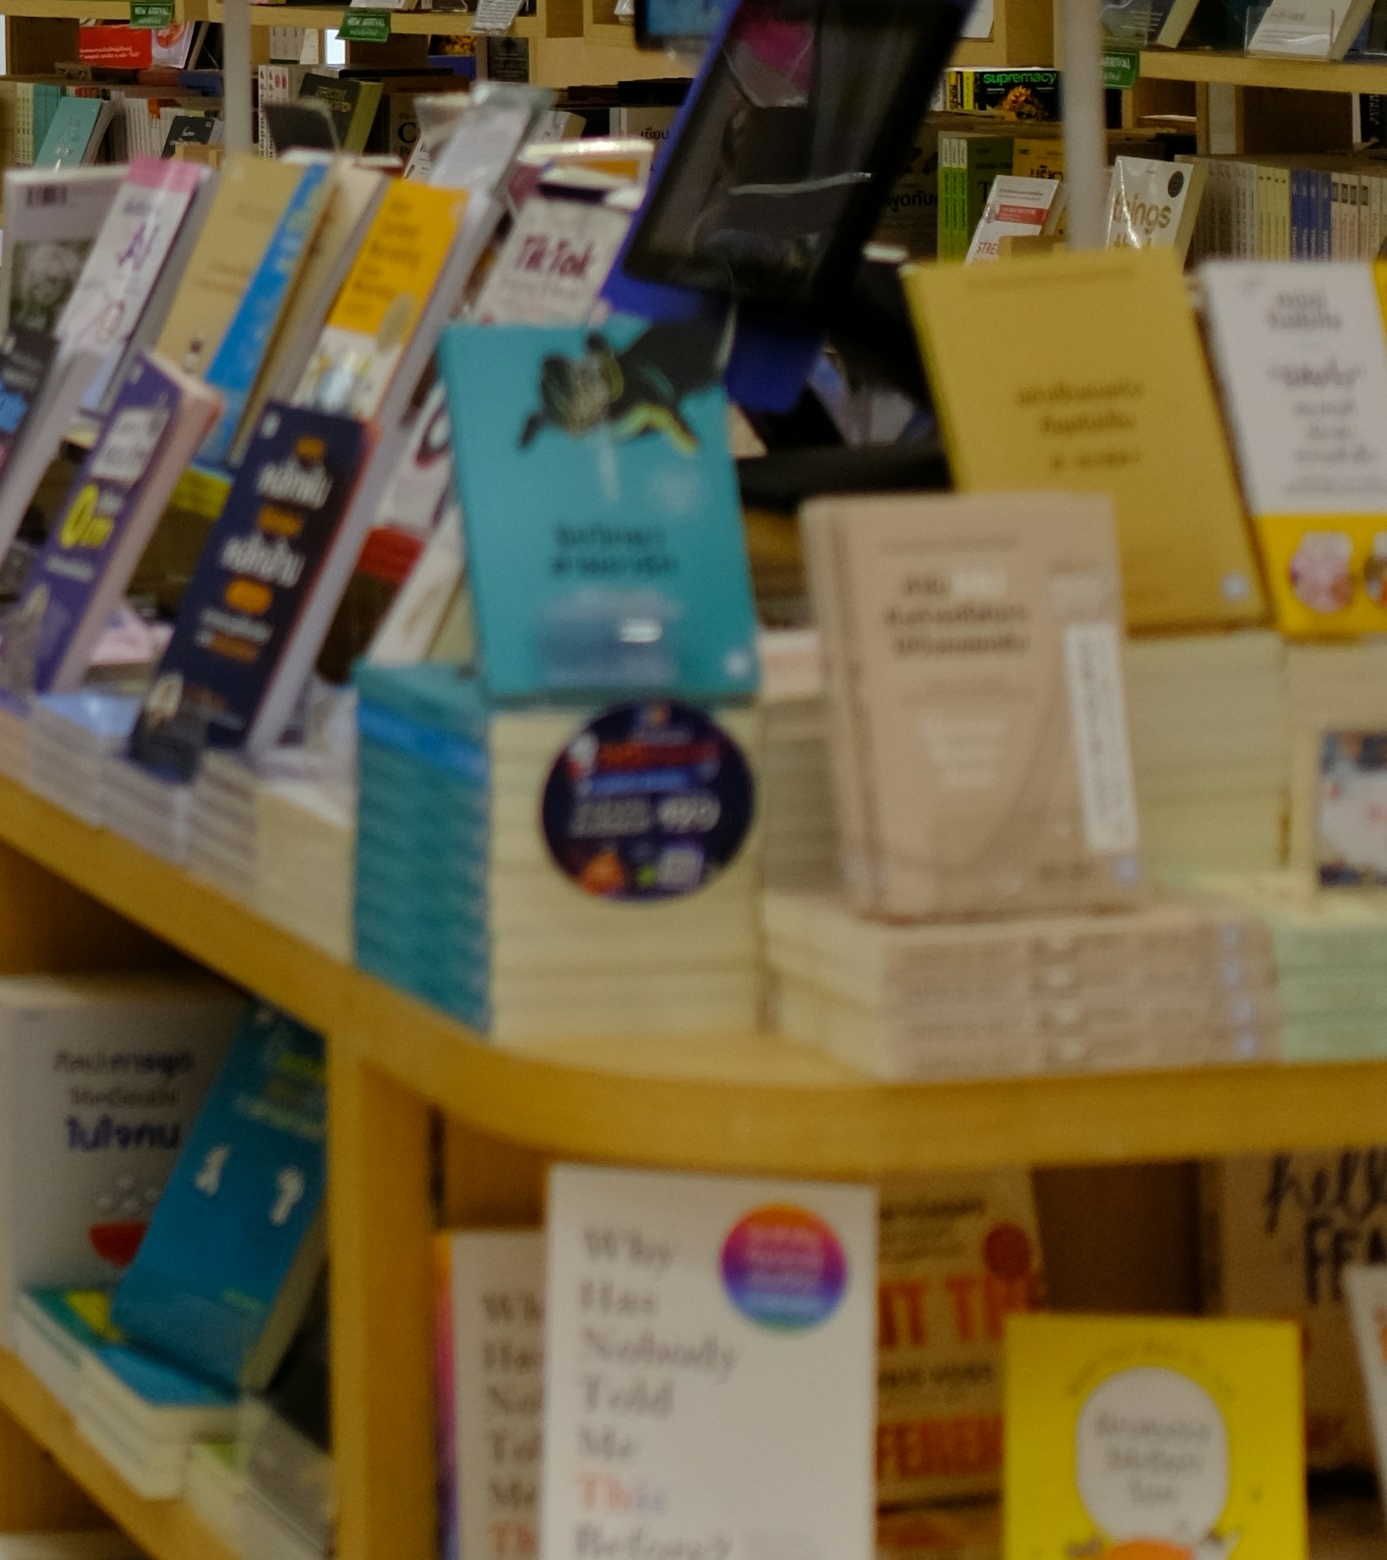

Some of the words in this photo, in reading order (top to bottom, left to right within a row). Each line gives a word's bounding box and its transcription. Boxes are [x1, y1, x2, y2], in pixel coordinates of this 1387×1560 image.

[982, 71, 1059, 87] supremacy
[581, 1225, 674, 1271] Why
[579, 1280, 659, 1316] Has
[580, 1326, 738, 1381] Nobody
[582, 1378, 675, 1418] Told
[580, 1430, 639, 1461] Me
[577, 1475, 668, 1513] This
